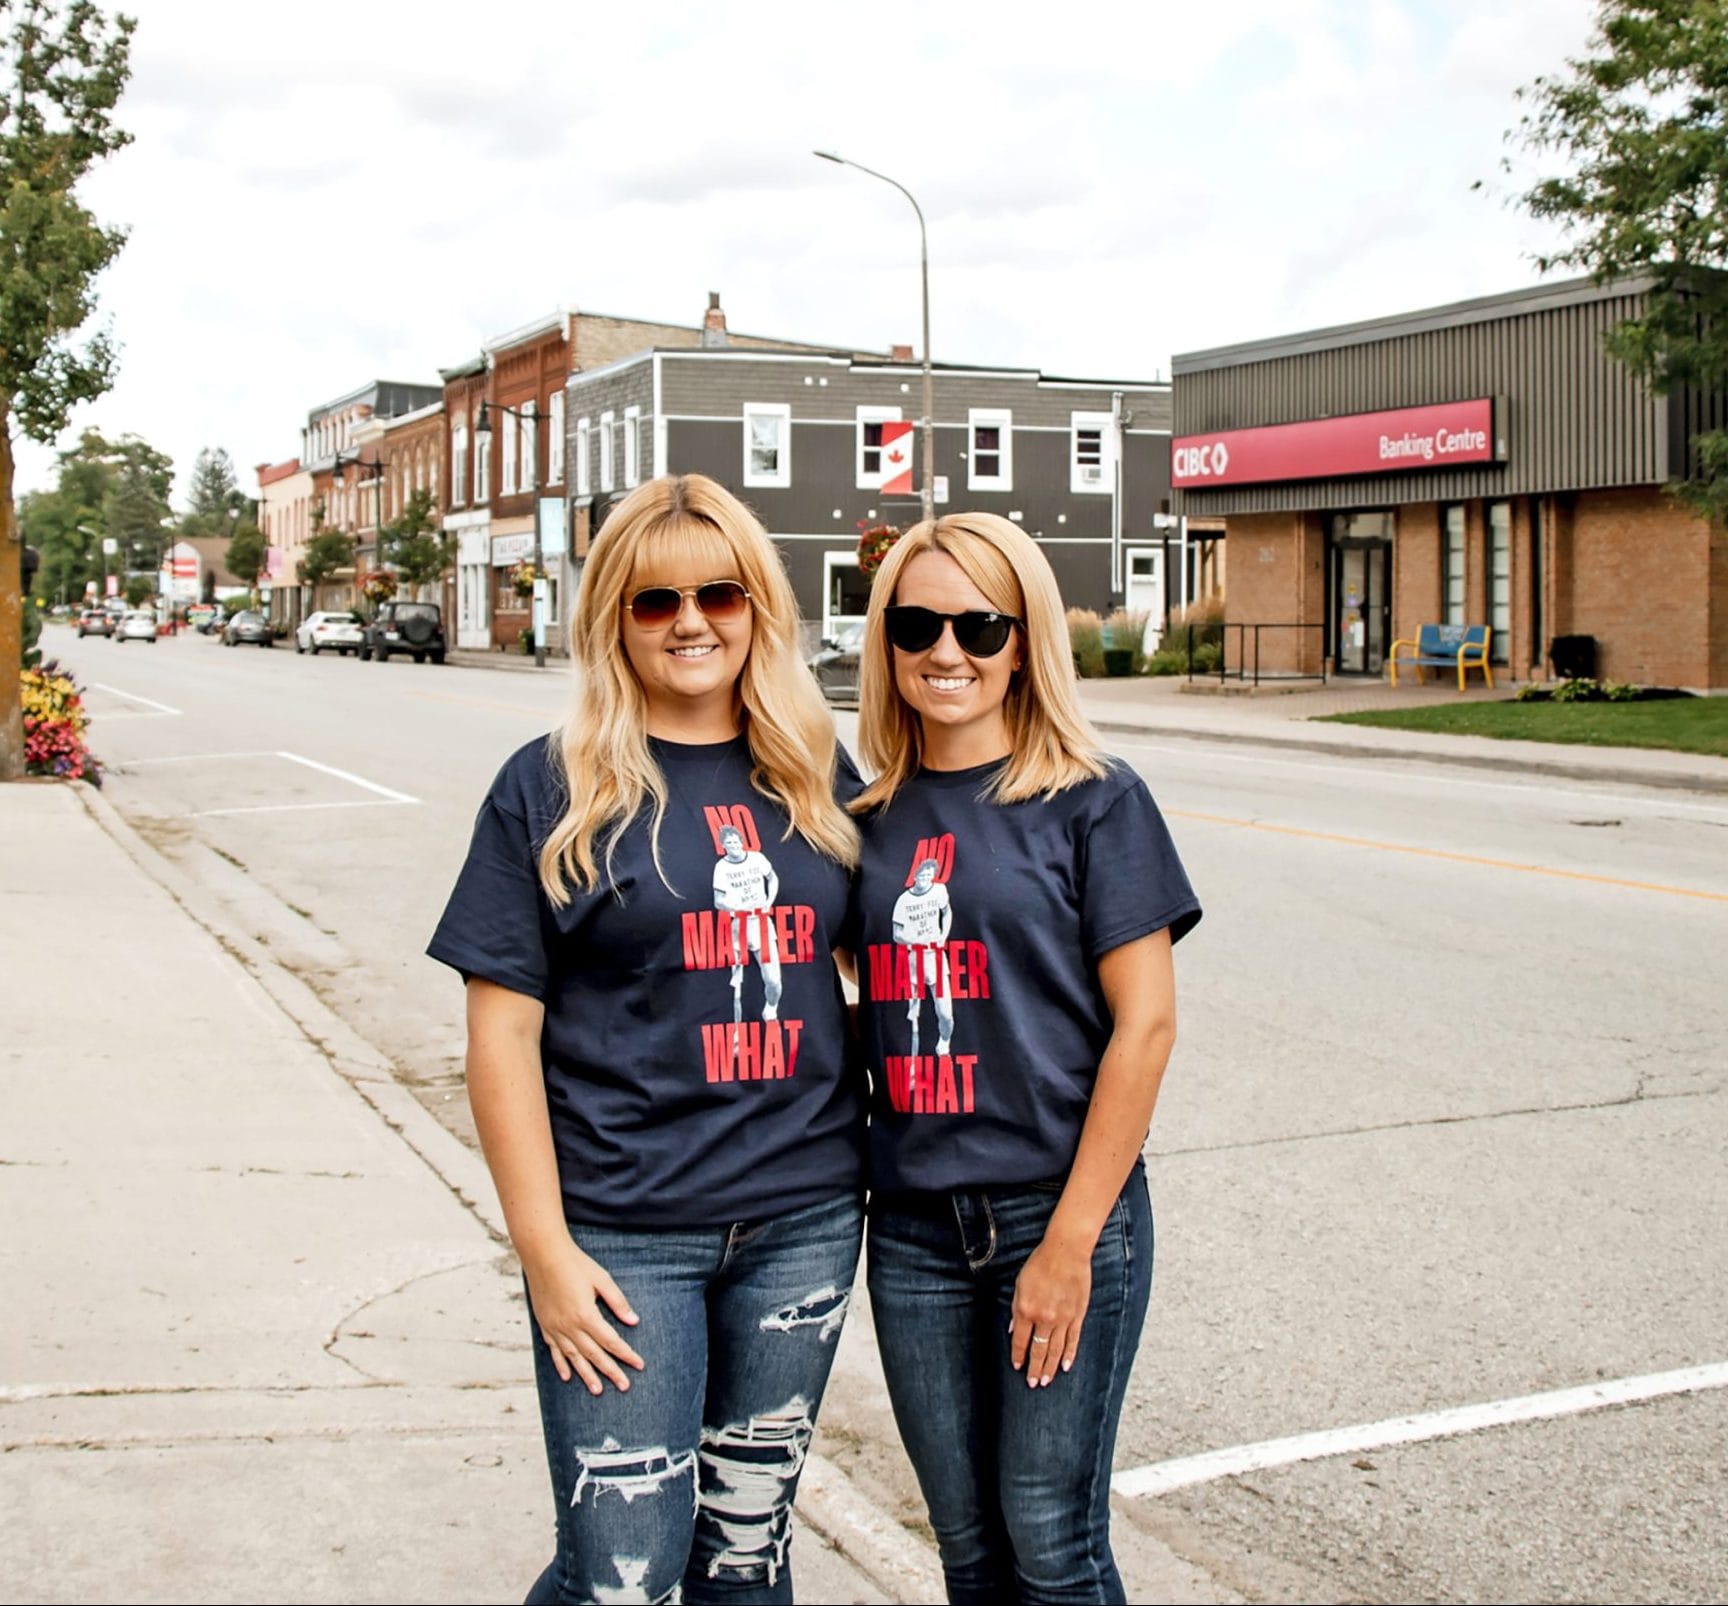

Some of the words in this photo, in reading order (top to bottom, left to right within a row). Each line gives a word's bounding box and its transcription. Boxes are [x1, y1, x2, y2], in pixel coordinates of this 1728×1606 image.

[1173, 445, 1211, 477] CIBC
[1379, 432, 1434, 460] Banking
[1436, 427, 1486, 454] Centre
[703, 803, 762, 856] NO
[905, 832, 956, 888] NO
[681, 905, 816, 972] MATTER
[868, 940, 991, 1002] MATTER
[701, 1019, 804, 1084] WHAT
[886, 1055, 979, 1114] WHAT
